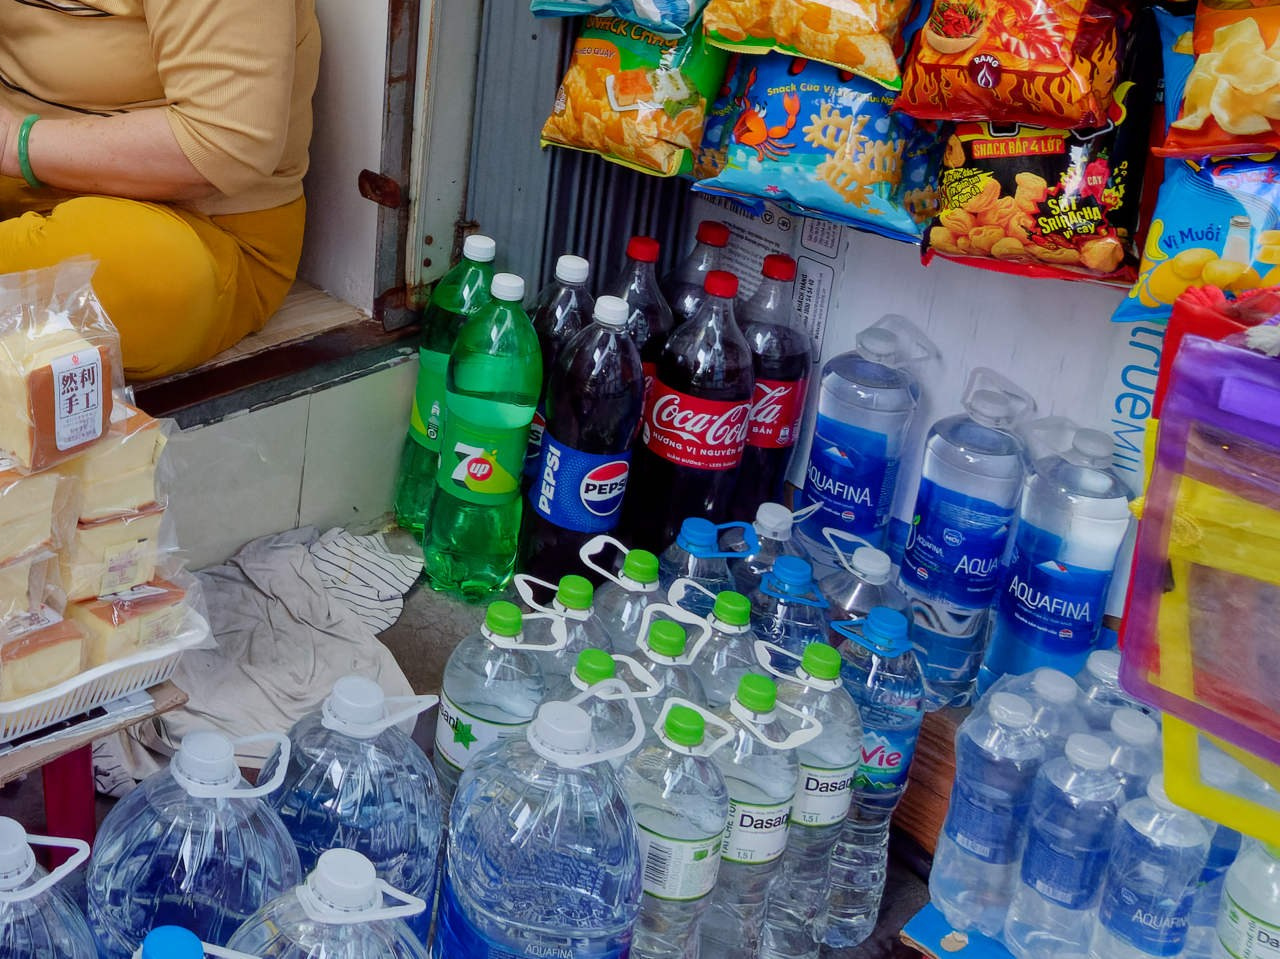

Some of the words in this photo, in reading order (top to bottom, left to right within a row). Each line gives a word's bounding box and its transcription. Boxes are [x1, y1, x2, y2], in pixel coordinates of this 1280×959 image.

[594, 47, 615, 58] QUAY
[973, 54, 999, 69] RANG
[767, 83, 796, 96] Snack
[800, 83, 820, 91] Cua
[973, 142, 1005, 156] SNACK
[1030, 143, 1039, 151] 4
[1088, 176, 1103, 185] CAY
[1047, 195, 1077, 212] SỐT
[1038, 206, 1101, 234] SRIRACHA
[1077, 223, 1096, 234] cay
[1162, 231, 1176, 250] Vị
[1179, 225, 1221, 244] Muối
[539, 444, 562, 516] PEPSI
[584, 478, 628, 496] PEPSI
[807, 462, 873, 507] AQUAFINA
[1008, 574, 1091, 622] AQUAFINA
[739, 810, 791, 830] Dasani
[524, 943, 574, 959] AQUAFINA
